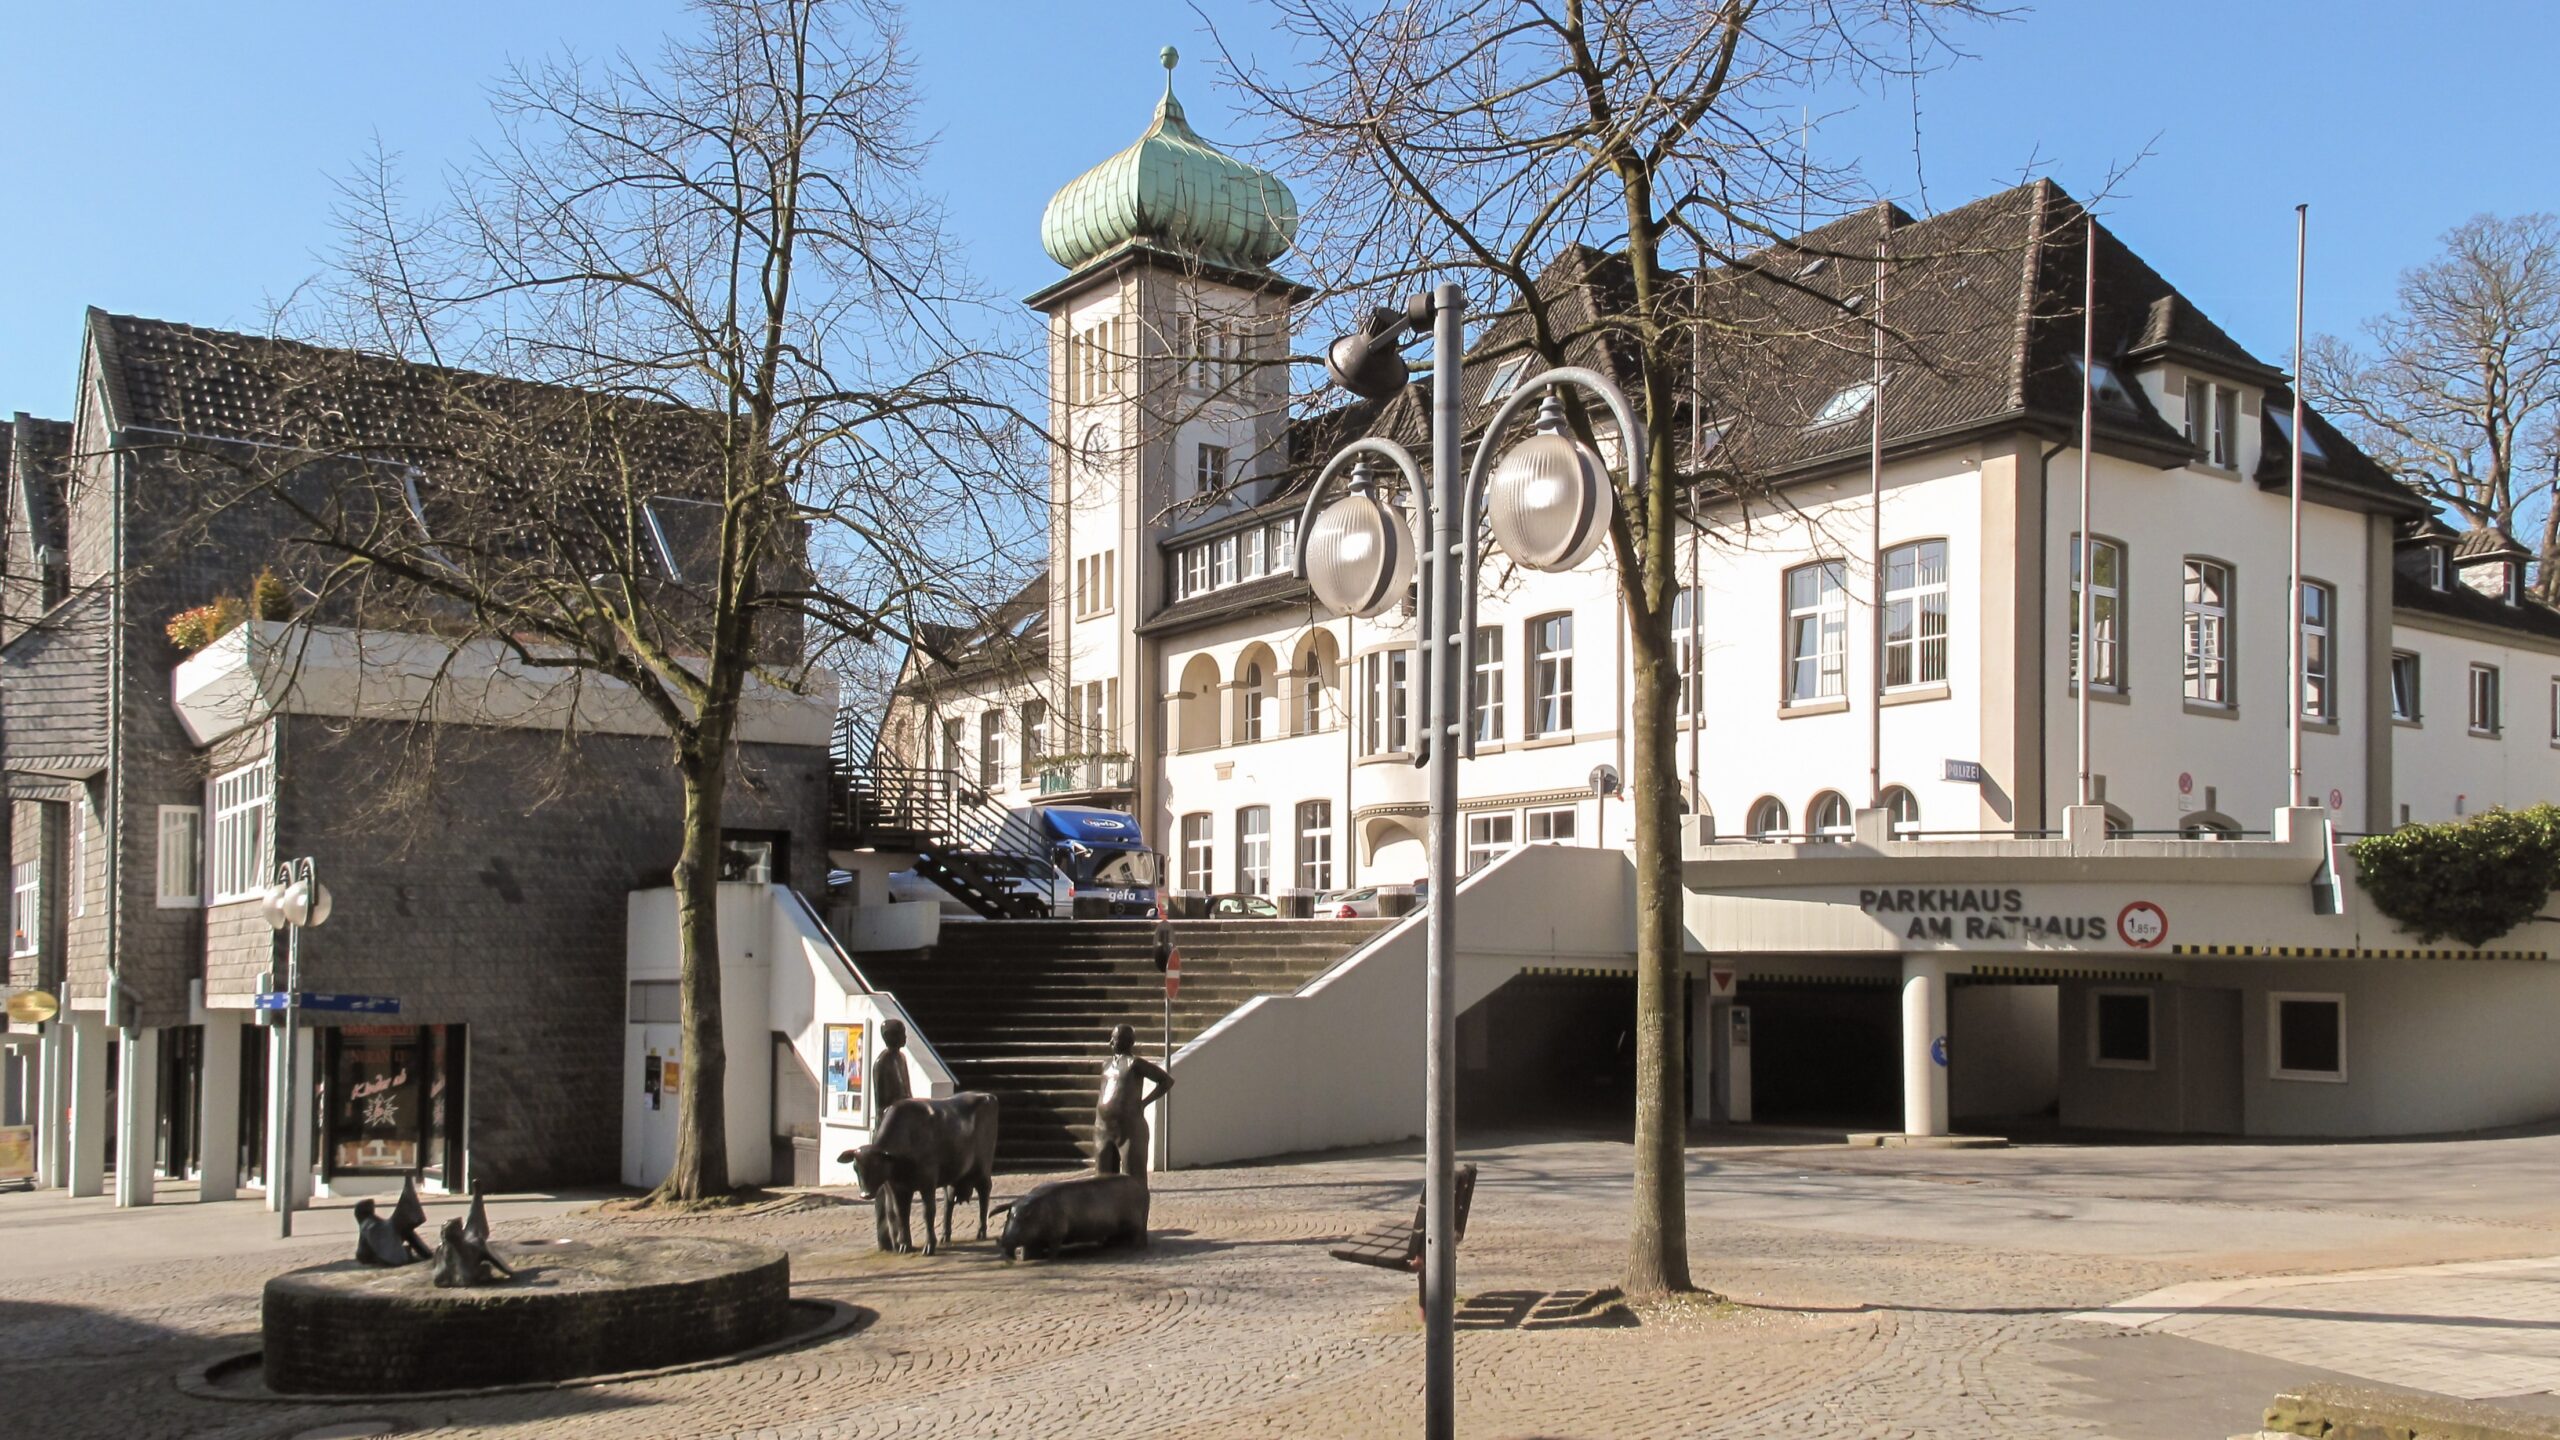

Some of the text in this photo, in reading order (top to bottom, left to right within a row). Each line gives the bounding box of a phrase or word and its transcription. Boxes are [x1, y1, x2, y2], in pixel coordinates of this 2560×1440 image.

[1947, 763, 1980, 779] POLIZEI
[1107, 888, 1136, 902] gefa
[1860, 889, 2022, 912] PARKHAUS
[1907, 916, 2107, 939] AM RATHAUS
